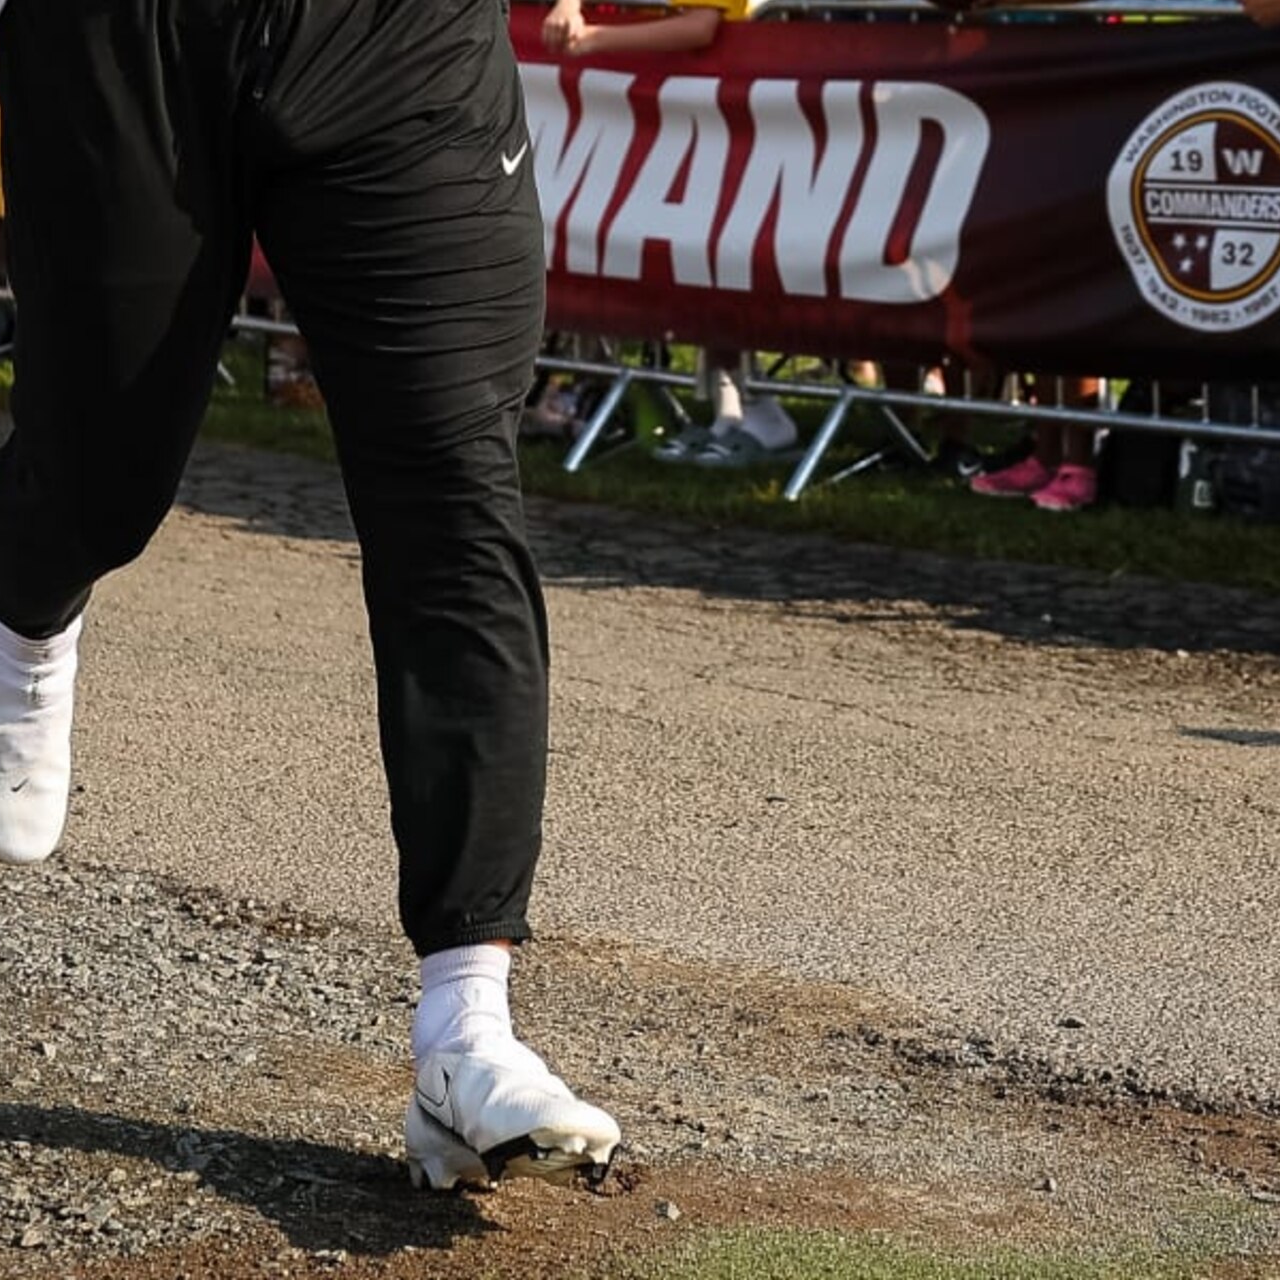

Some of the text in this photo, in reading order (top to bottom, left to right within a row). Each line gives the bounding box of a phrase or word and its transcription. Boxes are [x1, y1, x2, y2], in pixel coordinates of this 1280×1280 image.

[1125, 89, 1234, 164] WASHINGTON
[1170, 149, 1204, 173] 19
[1222, 148, 1264, 176] W
[518, 62, 990, 304] MAND
[1221, 241, 1255, 268] 32
